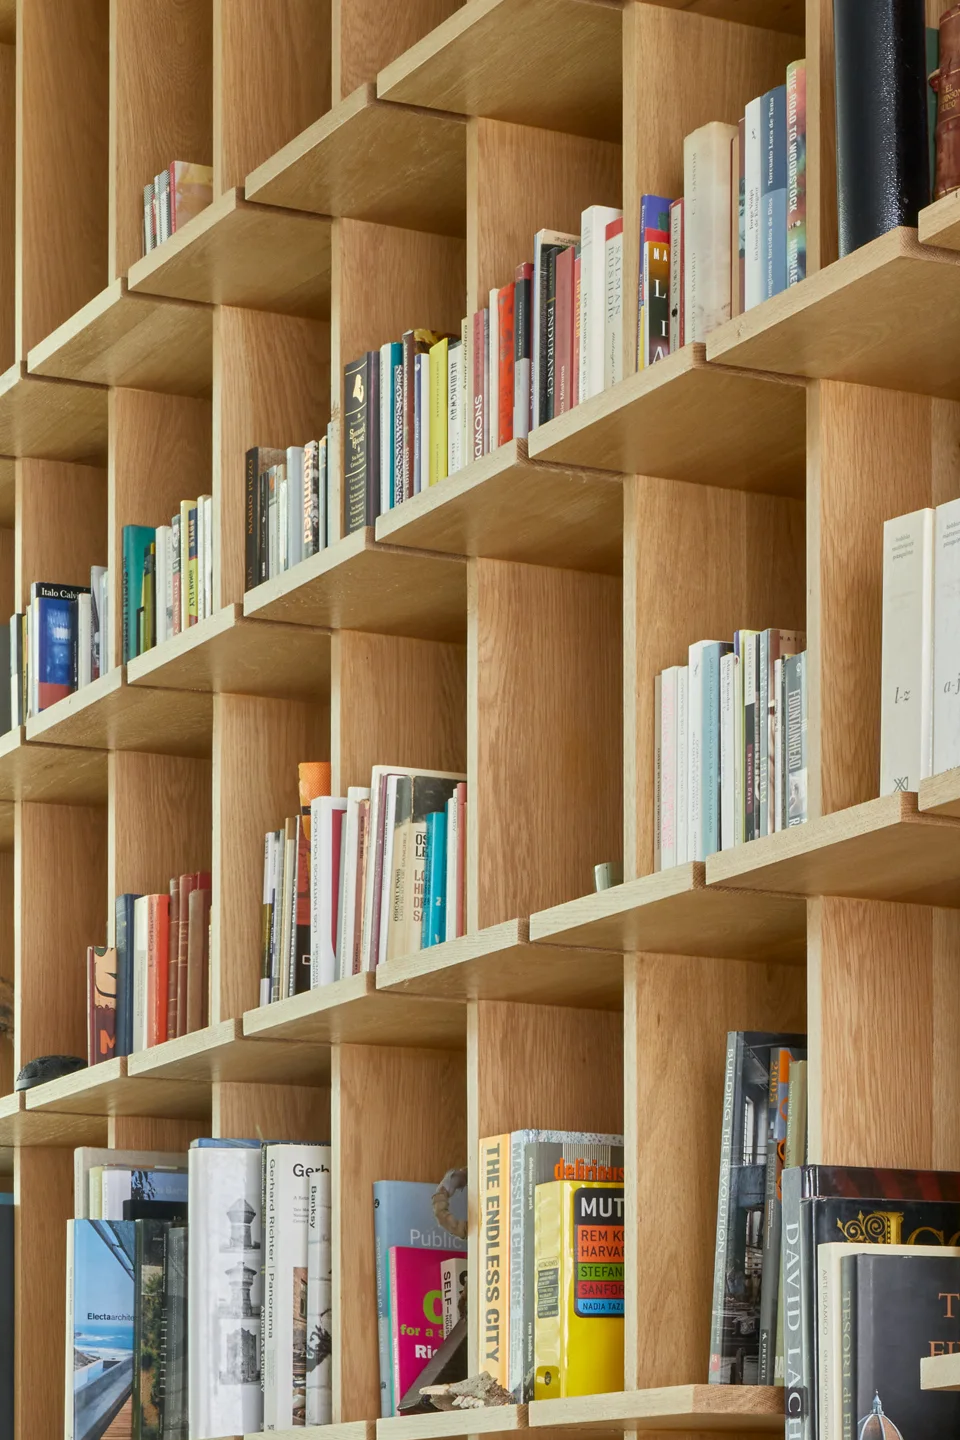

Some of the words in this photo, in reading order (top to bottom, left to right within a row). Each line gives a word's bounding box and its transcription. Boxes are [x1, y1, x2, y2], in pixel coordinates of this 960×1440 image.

[789, 69, 797, 89] THE
[789, 91, 798, 118] ROAD
[789, 139, 798, 212] WOODSTOCK
[546, 306, 555, 397] ENDURANCE
[304, 448, 312, 543] Atomised
[41, 587, 58, 597] Italo
[788, 689, 802, 770] FOUNTAINHEAD
[724, 1048, 733, 1121] BUILDING
[769, 1062, 778, 1102] 2005
[485, 1142, 501, 1191] THE
[722, 1124, 730, 1153] THE
[717, 1157, 729, 1253] REVOLUTION
[410, 1229, 462, 1249] Public
[485, 1195, 501, 1303] ENDLESS
[581, 1229, 610, 1243] REM
[786, 1222, 800, 1331] DAVID
[400, 1324, 420, 1336] for
[484, 1308, 500, 1364] CITY
[842, 1291, 851, 1379] TESORI
